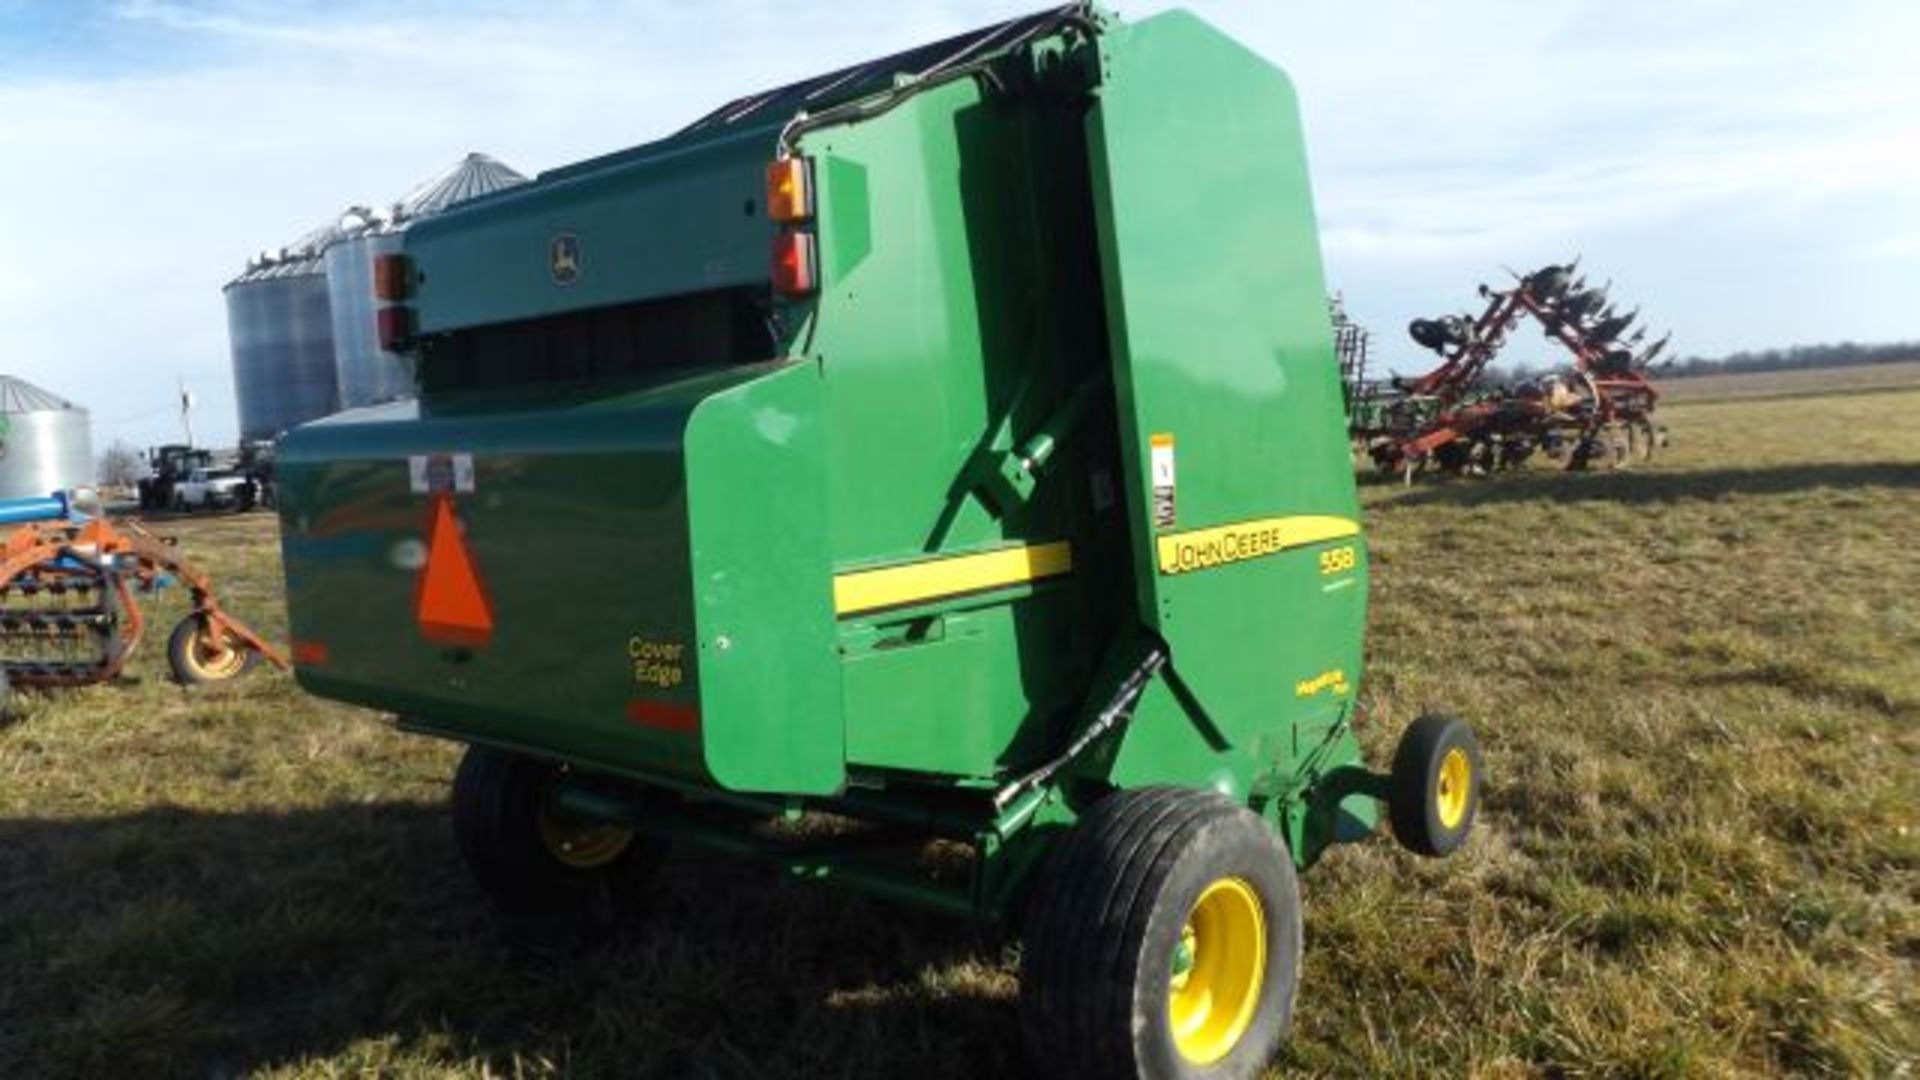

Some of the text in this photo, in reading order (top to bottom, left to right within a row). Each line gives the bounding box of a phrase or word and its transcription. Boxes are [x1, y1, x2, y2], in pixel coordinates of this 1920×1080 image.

[1169, 528, 1280, 569] JOHN DEERE
[628, 636, 684, 660] Cover
[635, 659, 682, 687] Edge
